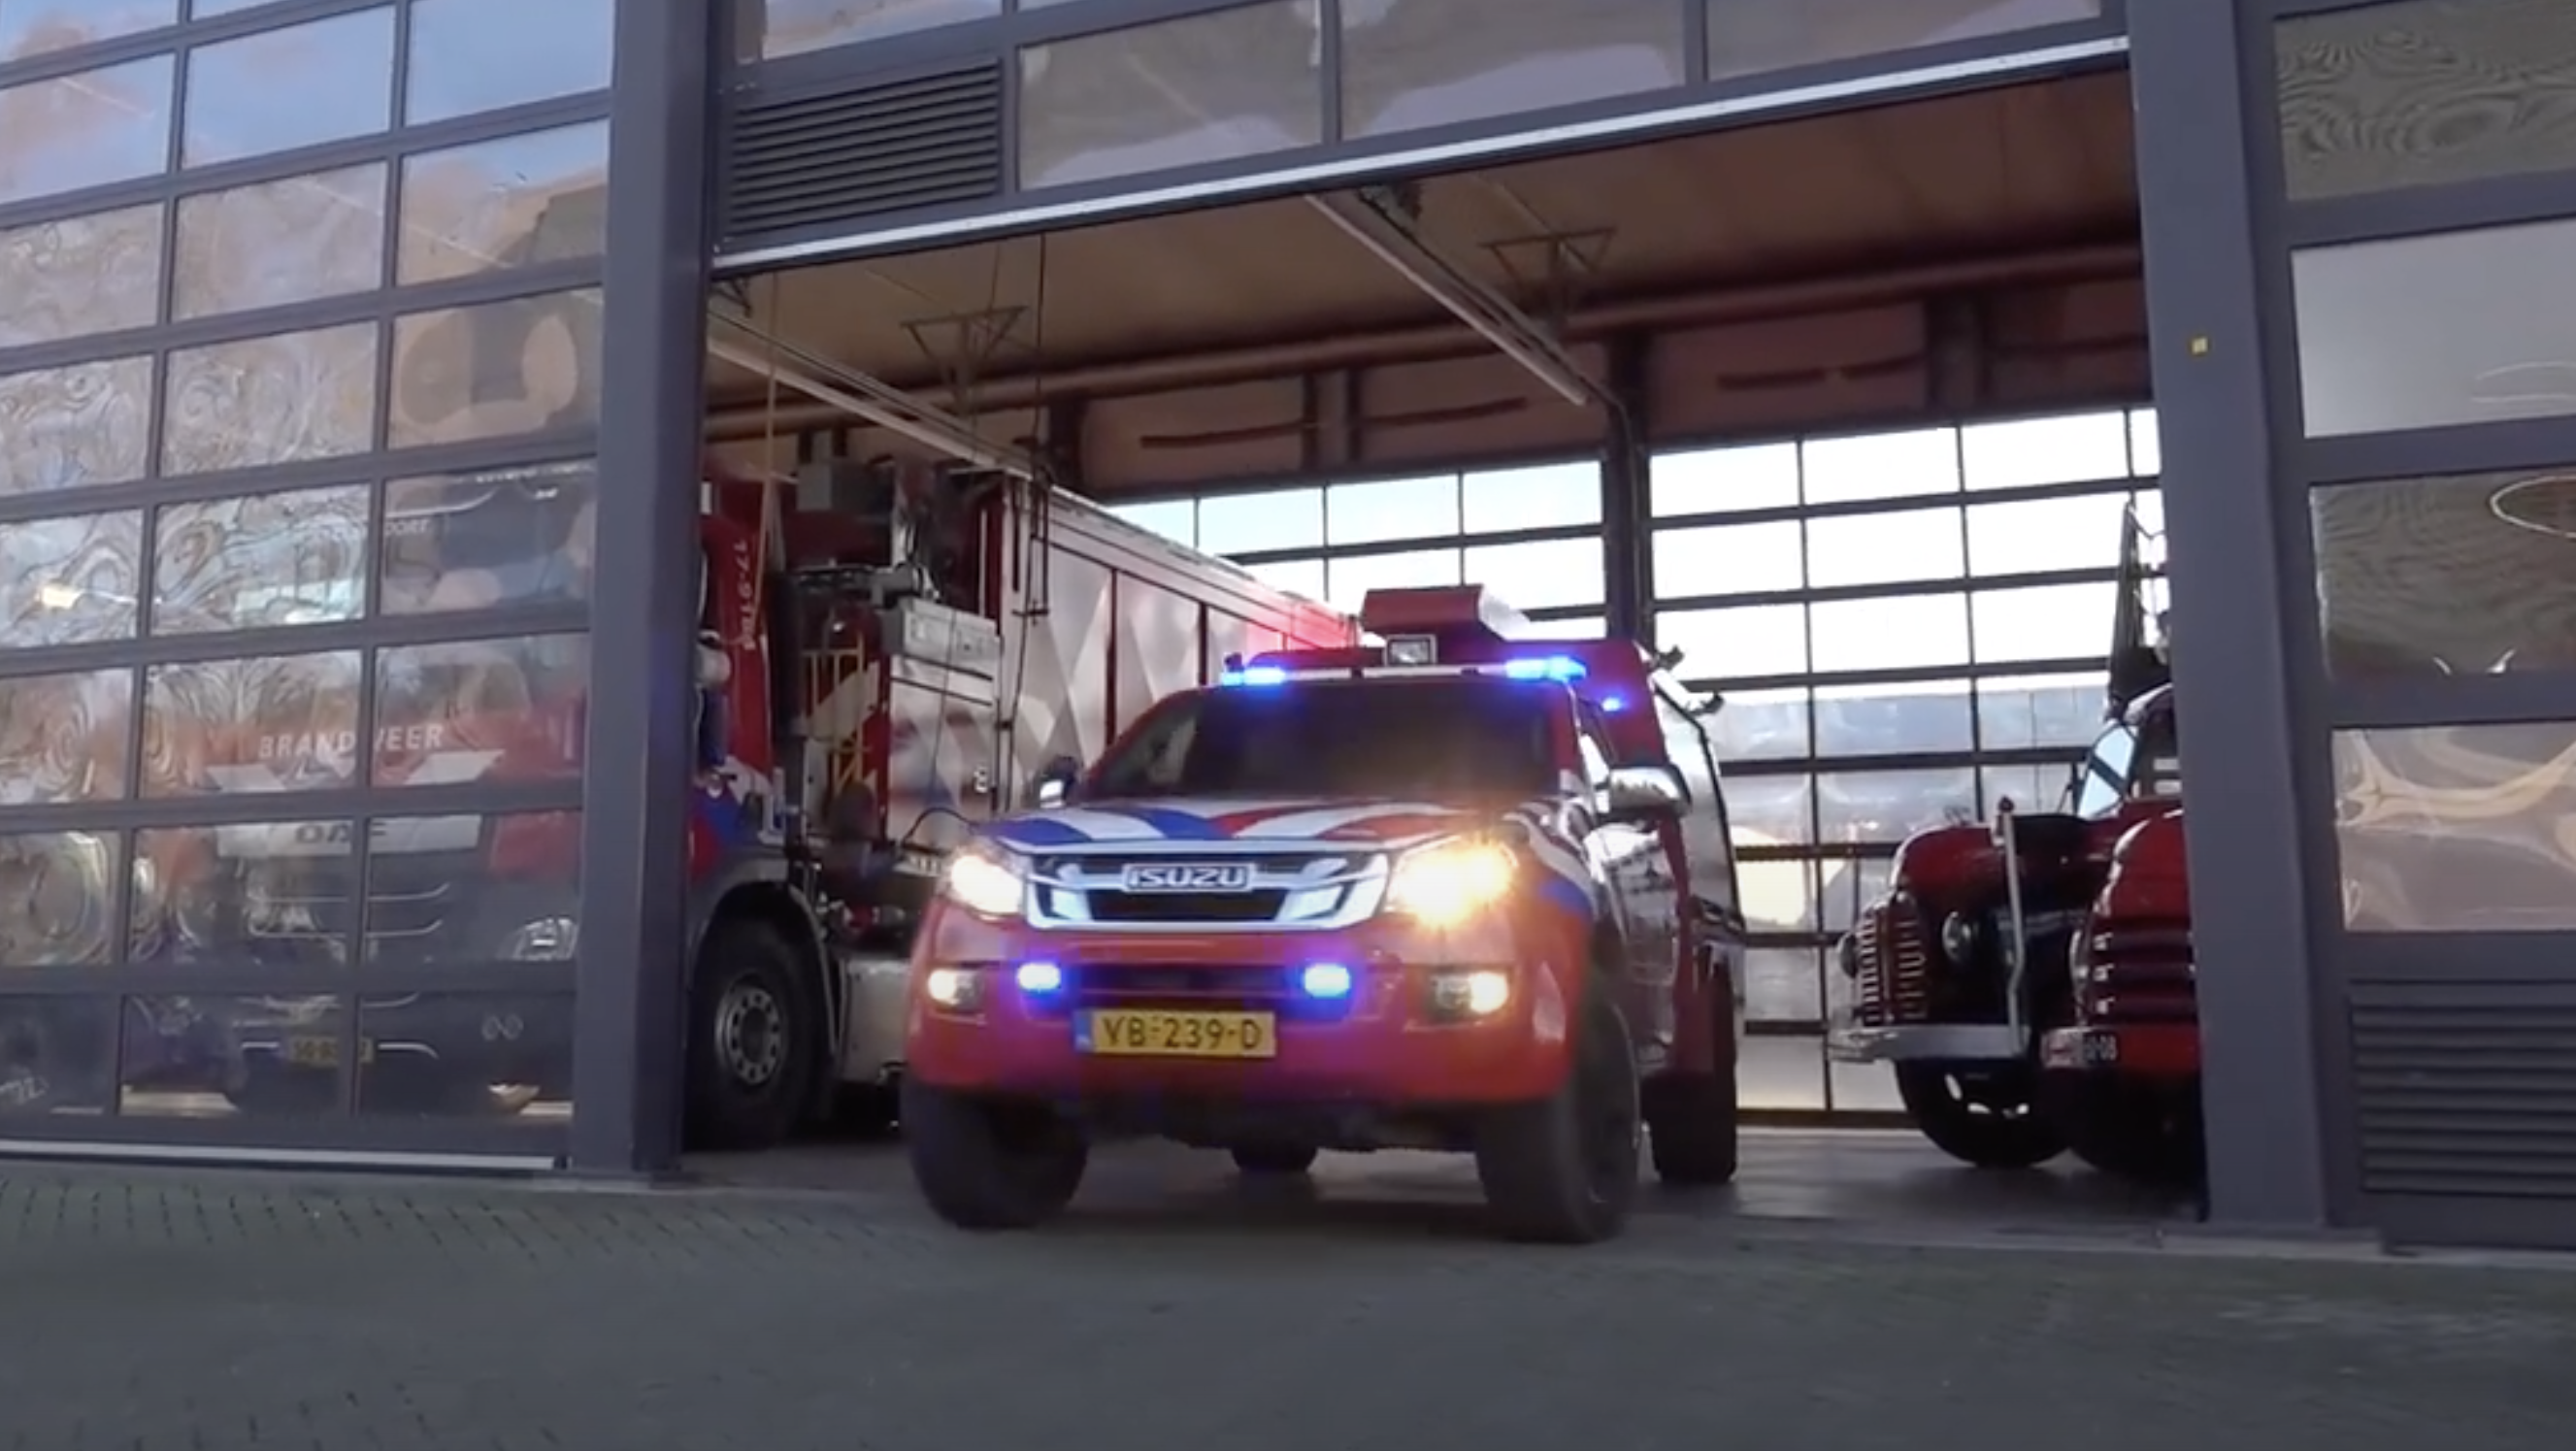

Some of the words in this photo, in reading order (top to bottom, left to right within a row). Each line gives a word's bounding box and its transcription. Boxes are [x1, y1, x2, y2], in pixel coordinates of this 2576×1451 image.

[258, 724, 444, 759] BRANDEER
[1129, 867, 1245, 889] ISUZU
[1102, 1015, 1261, 1050] VB-239-D
